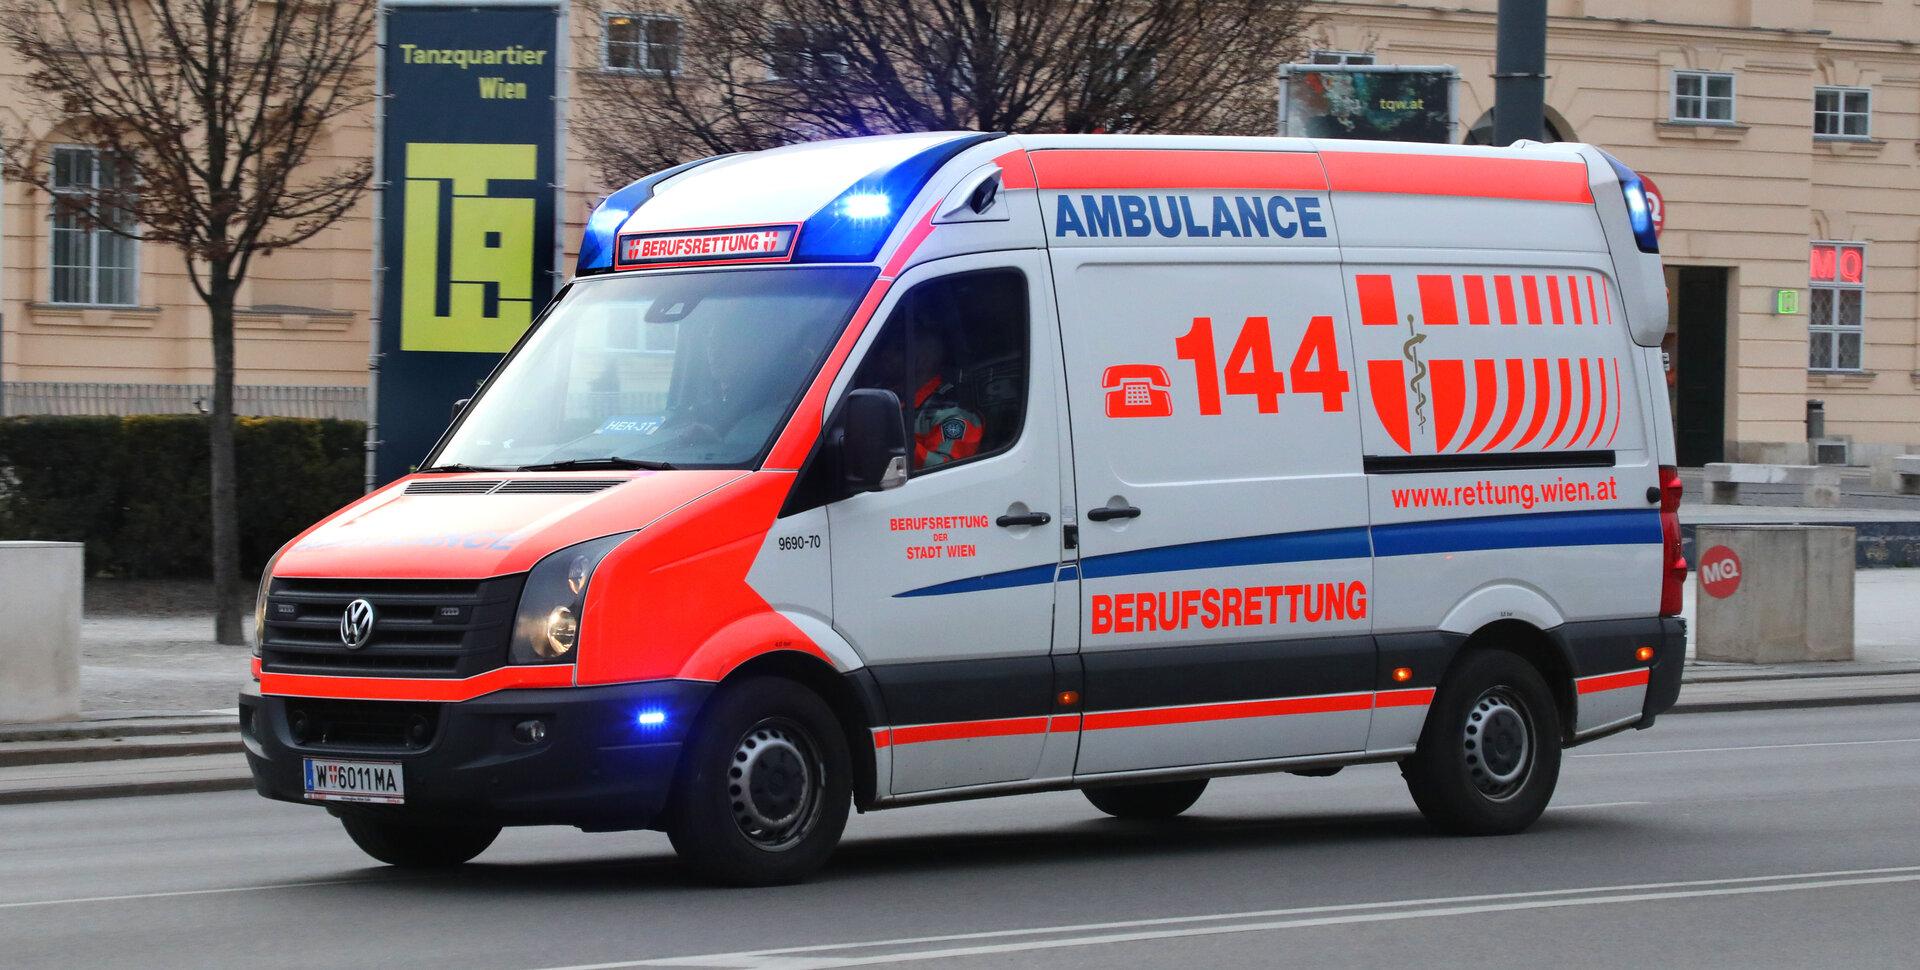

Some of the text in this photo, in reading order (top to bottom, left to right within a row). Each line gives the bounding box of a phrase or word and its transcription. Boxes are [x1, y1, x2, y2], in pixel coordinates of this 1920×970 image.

[399, 44, 547, 69] Tanzquartier
[479, 77, 527, 99] Wien
[1380, 99, 1424, 112] tqw.at
[1056, 194, 1327, 239] AMBULANCE
[641, 234, 759, 257] BERUFSRETTUNG
[1809, 248, 1863, 284] MQ
[1175, 316, 1350, 415] 144
[1391, 476, 1617, 510] www.rettung.wien.at
[890, 515, 989, 531] BERUFSRETTUNG
[779, 535, 821, 550] 9690-70
[933, 533, 949, 543] DER
[906, 544, 976, 560] STADT WIEN
[1702, 559, 1739, 584] MQ
[1092, 580, 1367, 634] BERUFSRETTUNG
[316, 765, 327, 788] W
